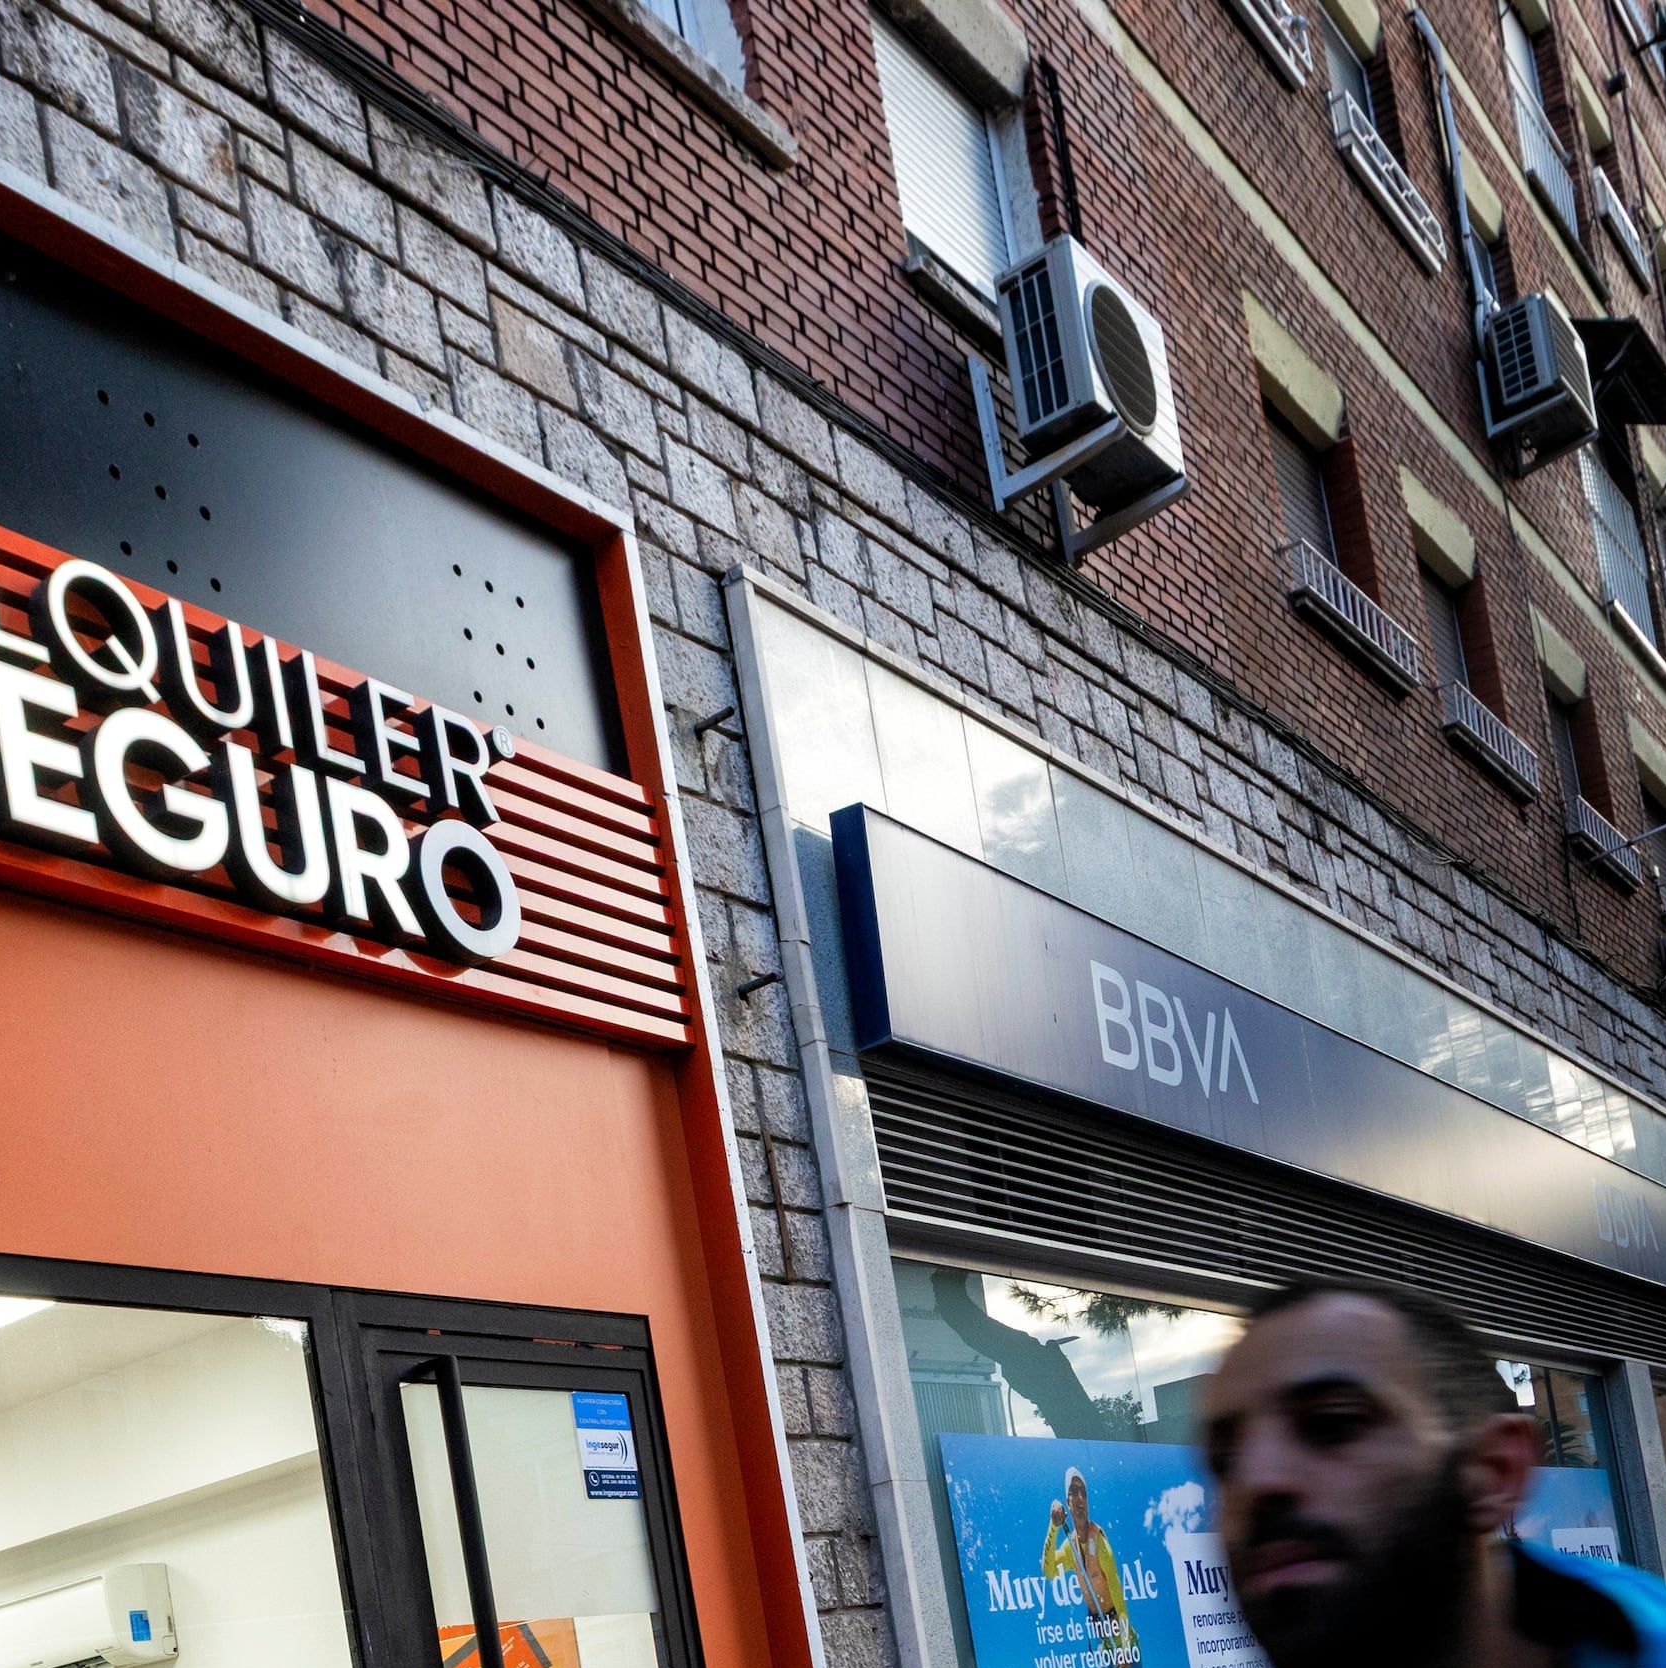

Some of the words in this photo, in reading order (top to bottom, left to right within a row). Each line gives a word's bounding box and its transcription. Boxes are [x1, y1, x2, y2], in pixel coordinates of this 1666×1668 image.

[1089, 958, 1261, 1106] BBVA
[1592, 1177, 1660, 1252] BBVA
[585, 1439, 620, 1451] ingesegur
[985, 1569, 1047, 1619] Muy
[1052, 1563, 1083, 1607] de
[1122, 1558, 1158, 1601] Ale
[1184, 1559, 1229, 1602] Muy
[1035, 1620, 1063, 1645] irse
[1066, 1617, 1084, 1642] de
[1085, 1613, 1120, 1639] finde
[1193, 1611, 1236, 1628] renovarse
[1197, 1631, 1255, 1655] incorporando
